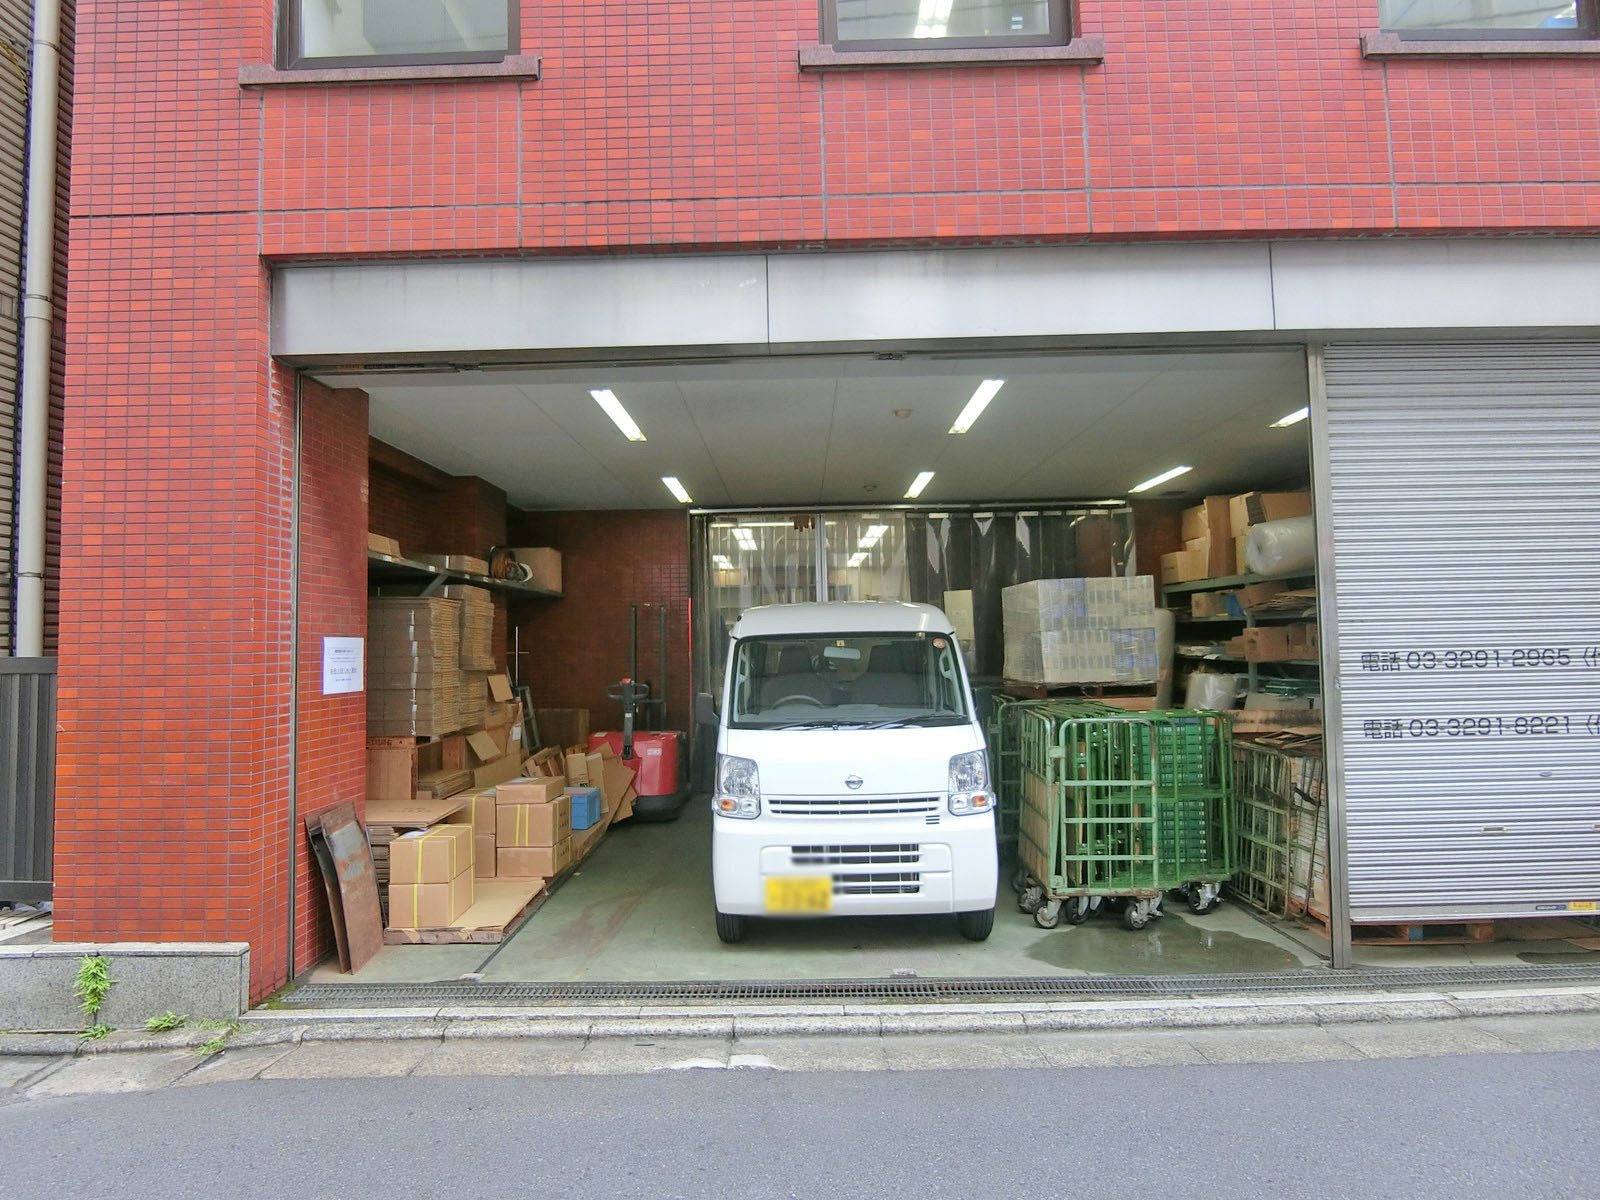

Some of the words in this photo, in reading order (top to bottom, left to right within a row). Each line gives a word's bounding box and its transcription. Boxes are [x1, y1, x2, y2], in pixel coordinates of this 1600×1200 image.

[1361, 651, 1400, 671] 電話
[1406, 648, 1571, 669] 03-3291-2965
[1363, 719, 1403, 739] 電話
[1409, 716, 1569, 737] 03-3291-8221
